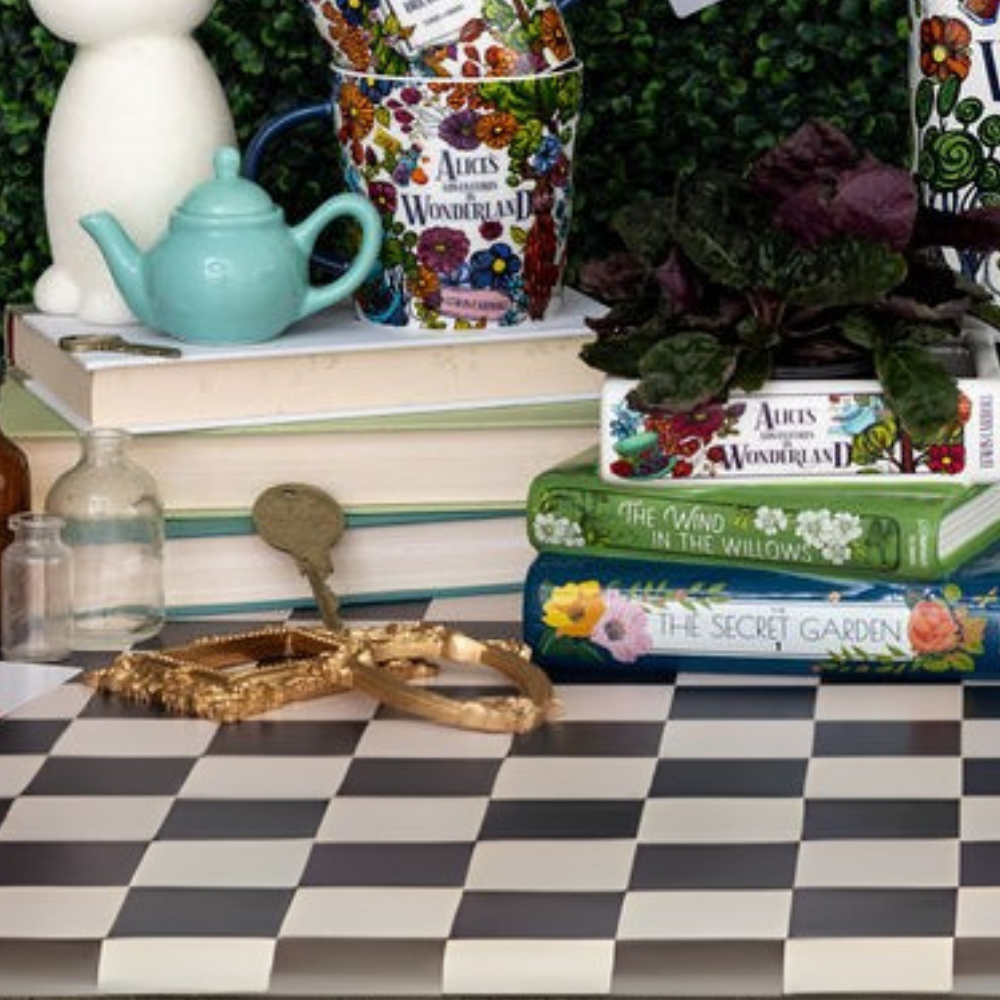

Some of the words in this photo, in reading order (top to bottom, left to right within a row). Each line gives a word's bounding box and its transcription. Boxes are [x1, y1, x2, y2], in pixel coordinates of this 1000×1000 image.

[402, 189, 532, 225] WONDERLAND
[721, 441, 853, 470] WONDERLAND
[652, 530, 670, 548] IN
[678, 532, 715, 554] THE
[722, 536, 812, 563] WILLOWS
[658, 613, 700, 638] THE
[710, 613, 788, 641] SECRET
[800, 617, 901, 643] GARDEN
